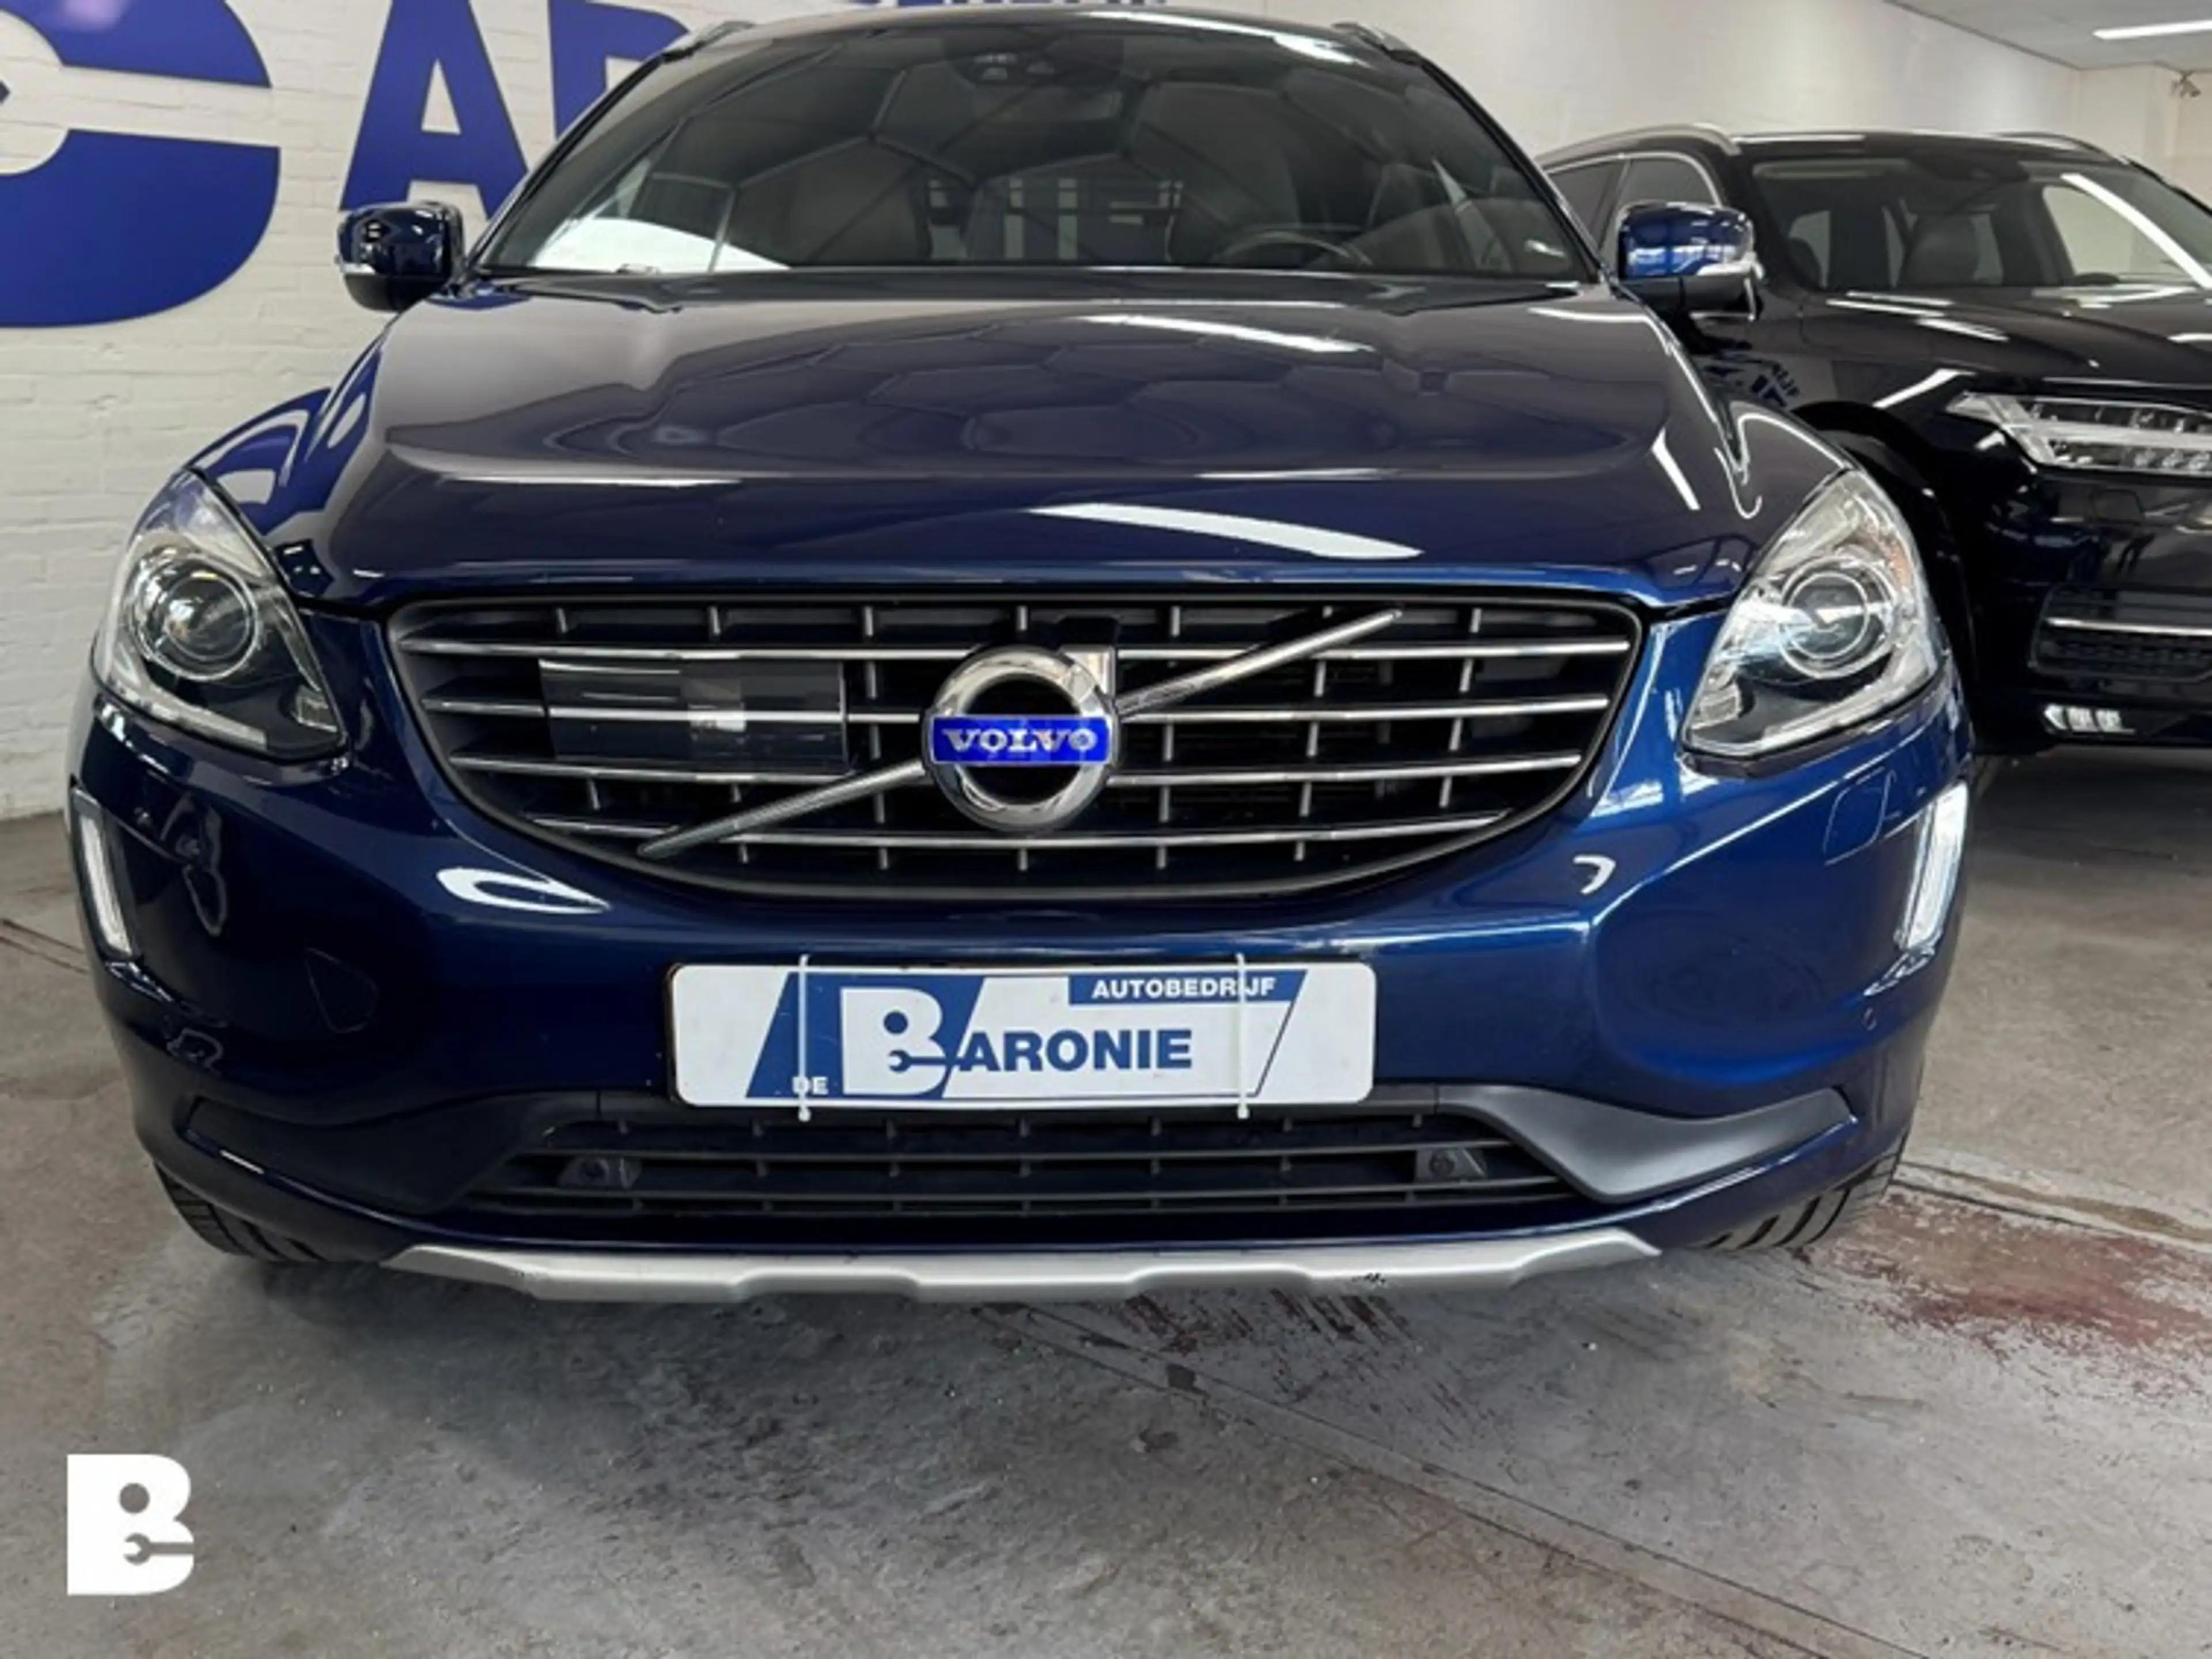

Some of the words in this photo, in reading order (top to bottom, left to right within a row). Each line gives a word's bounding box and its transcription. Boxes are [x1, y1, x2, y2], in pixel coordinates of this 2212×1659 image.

[942, 728, 1097, 752] VOLVO
[1092, 976, 1277, 999] AUTOBEDRJF
[792, 1076, 829, 1094] DE
[840, 987, 1192, 1095] BARONIE
